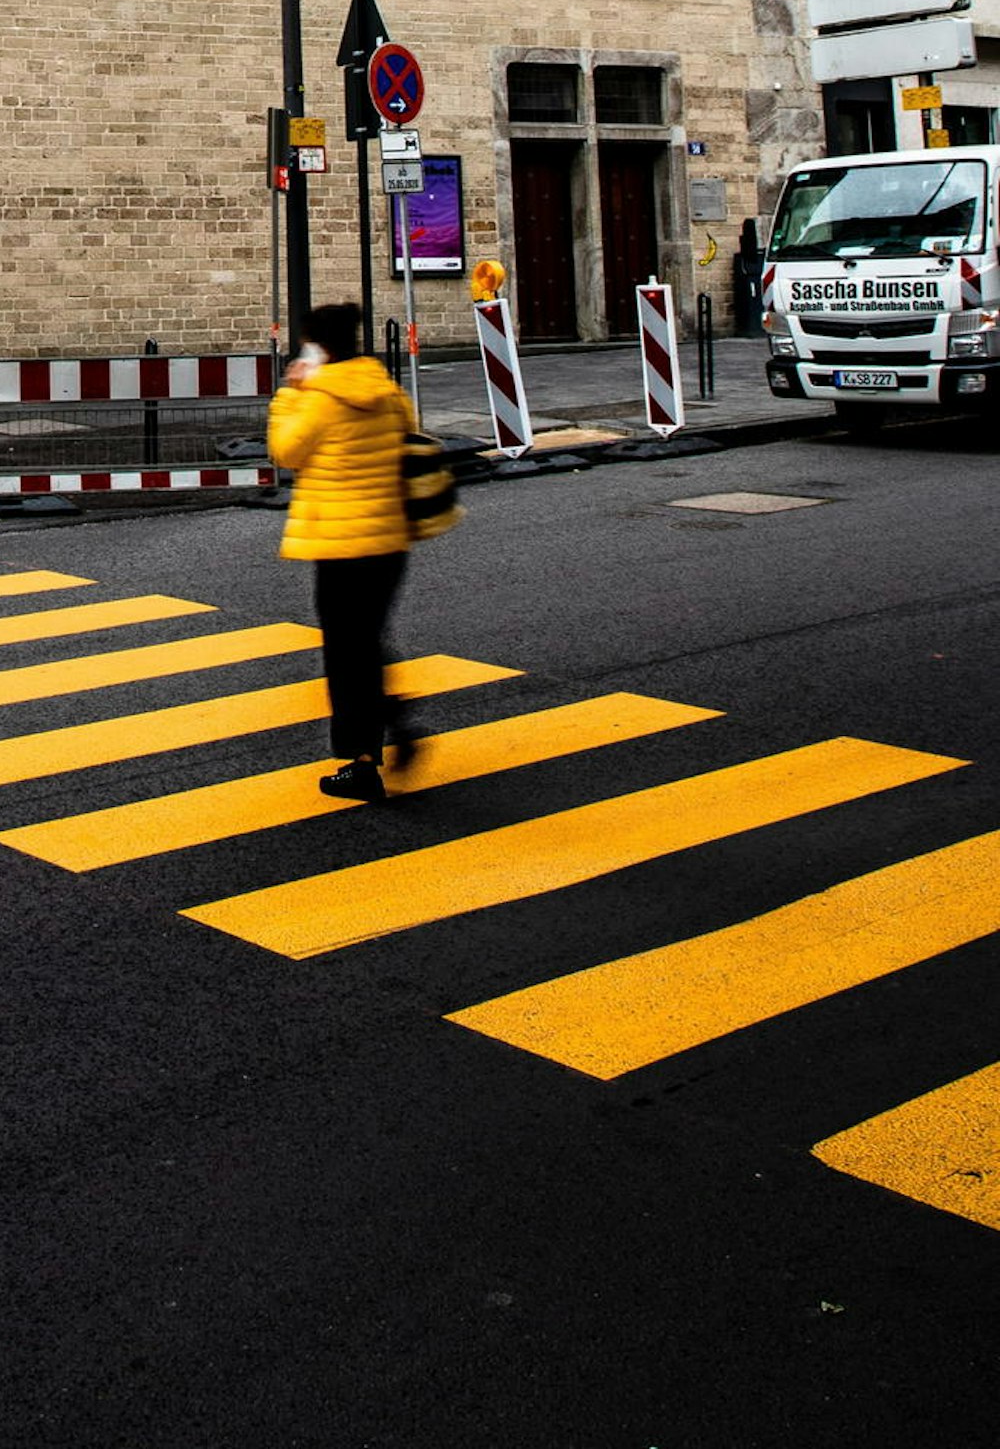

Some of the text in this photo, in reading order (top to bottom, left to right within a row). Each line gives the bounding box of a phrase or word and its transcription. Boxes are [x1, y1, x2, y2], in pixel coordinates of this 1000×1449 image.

[791, 280, 939, 300] Sascha Bunsen
[830, 301, 848, 311] und
[850, 300, 910, 311] Straßenbau
[912, 300, 945, 311] GmbH
[871, 374, 892, 386] 227
